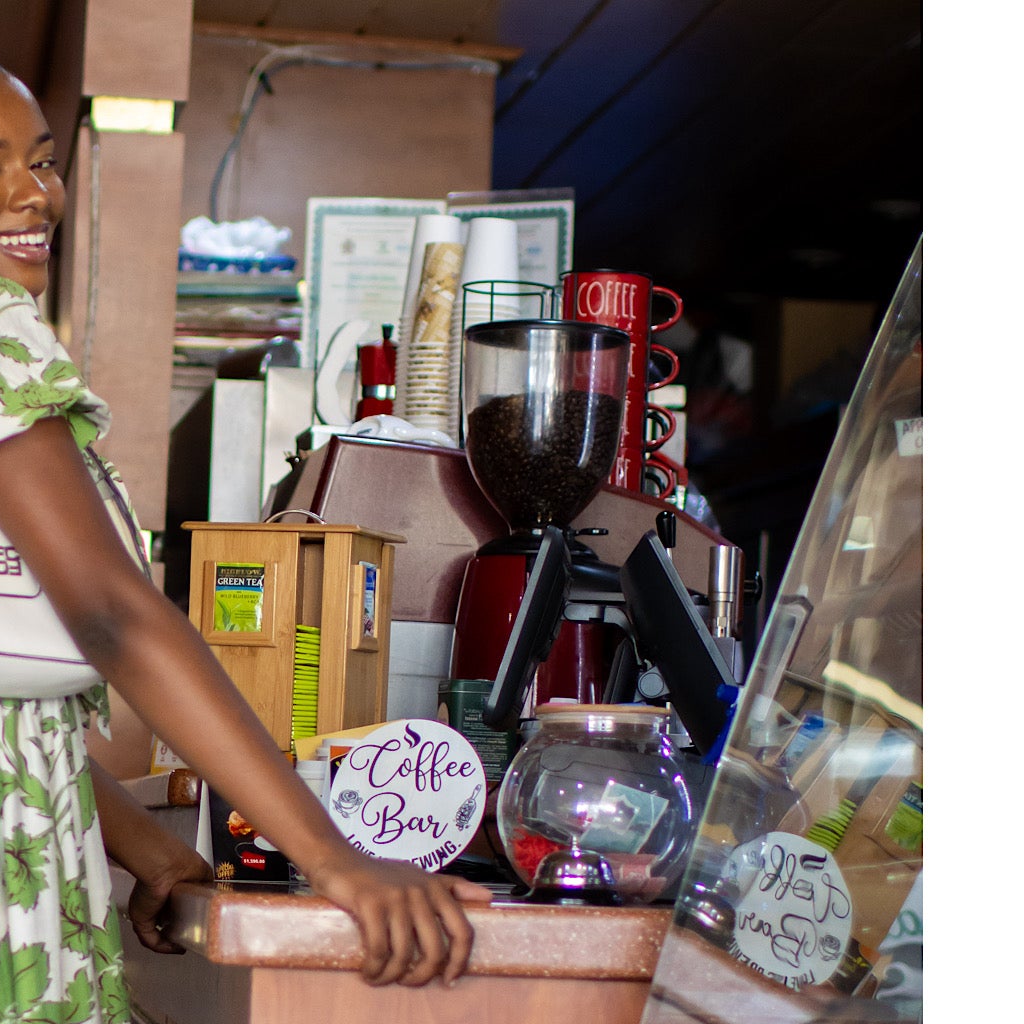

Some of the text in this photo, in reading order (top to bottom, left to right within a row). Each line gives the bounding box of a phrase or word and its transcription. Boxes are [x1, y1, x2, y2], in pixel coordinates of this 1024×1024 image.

[577, 280, 637, 319] COFFEE
[217, 577, 263, 587] GREEN TEA
[349, 739, 476, 792] Coffee
[361, 791, 448, 845] Bar
[411, 840, 462, 870] WING.
